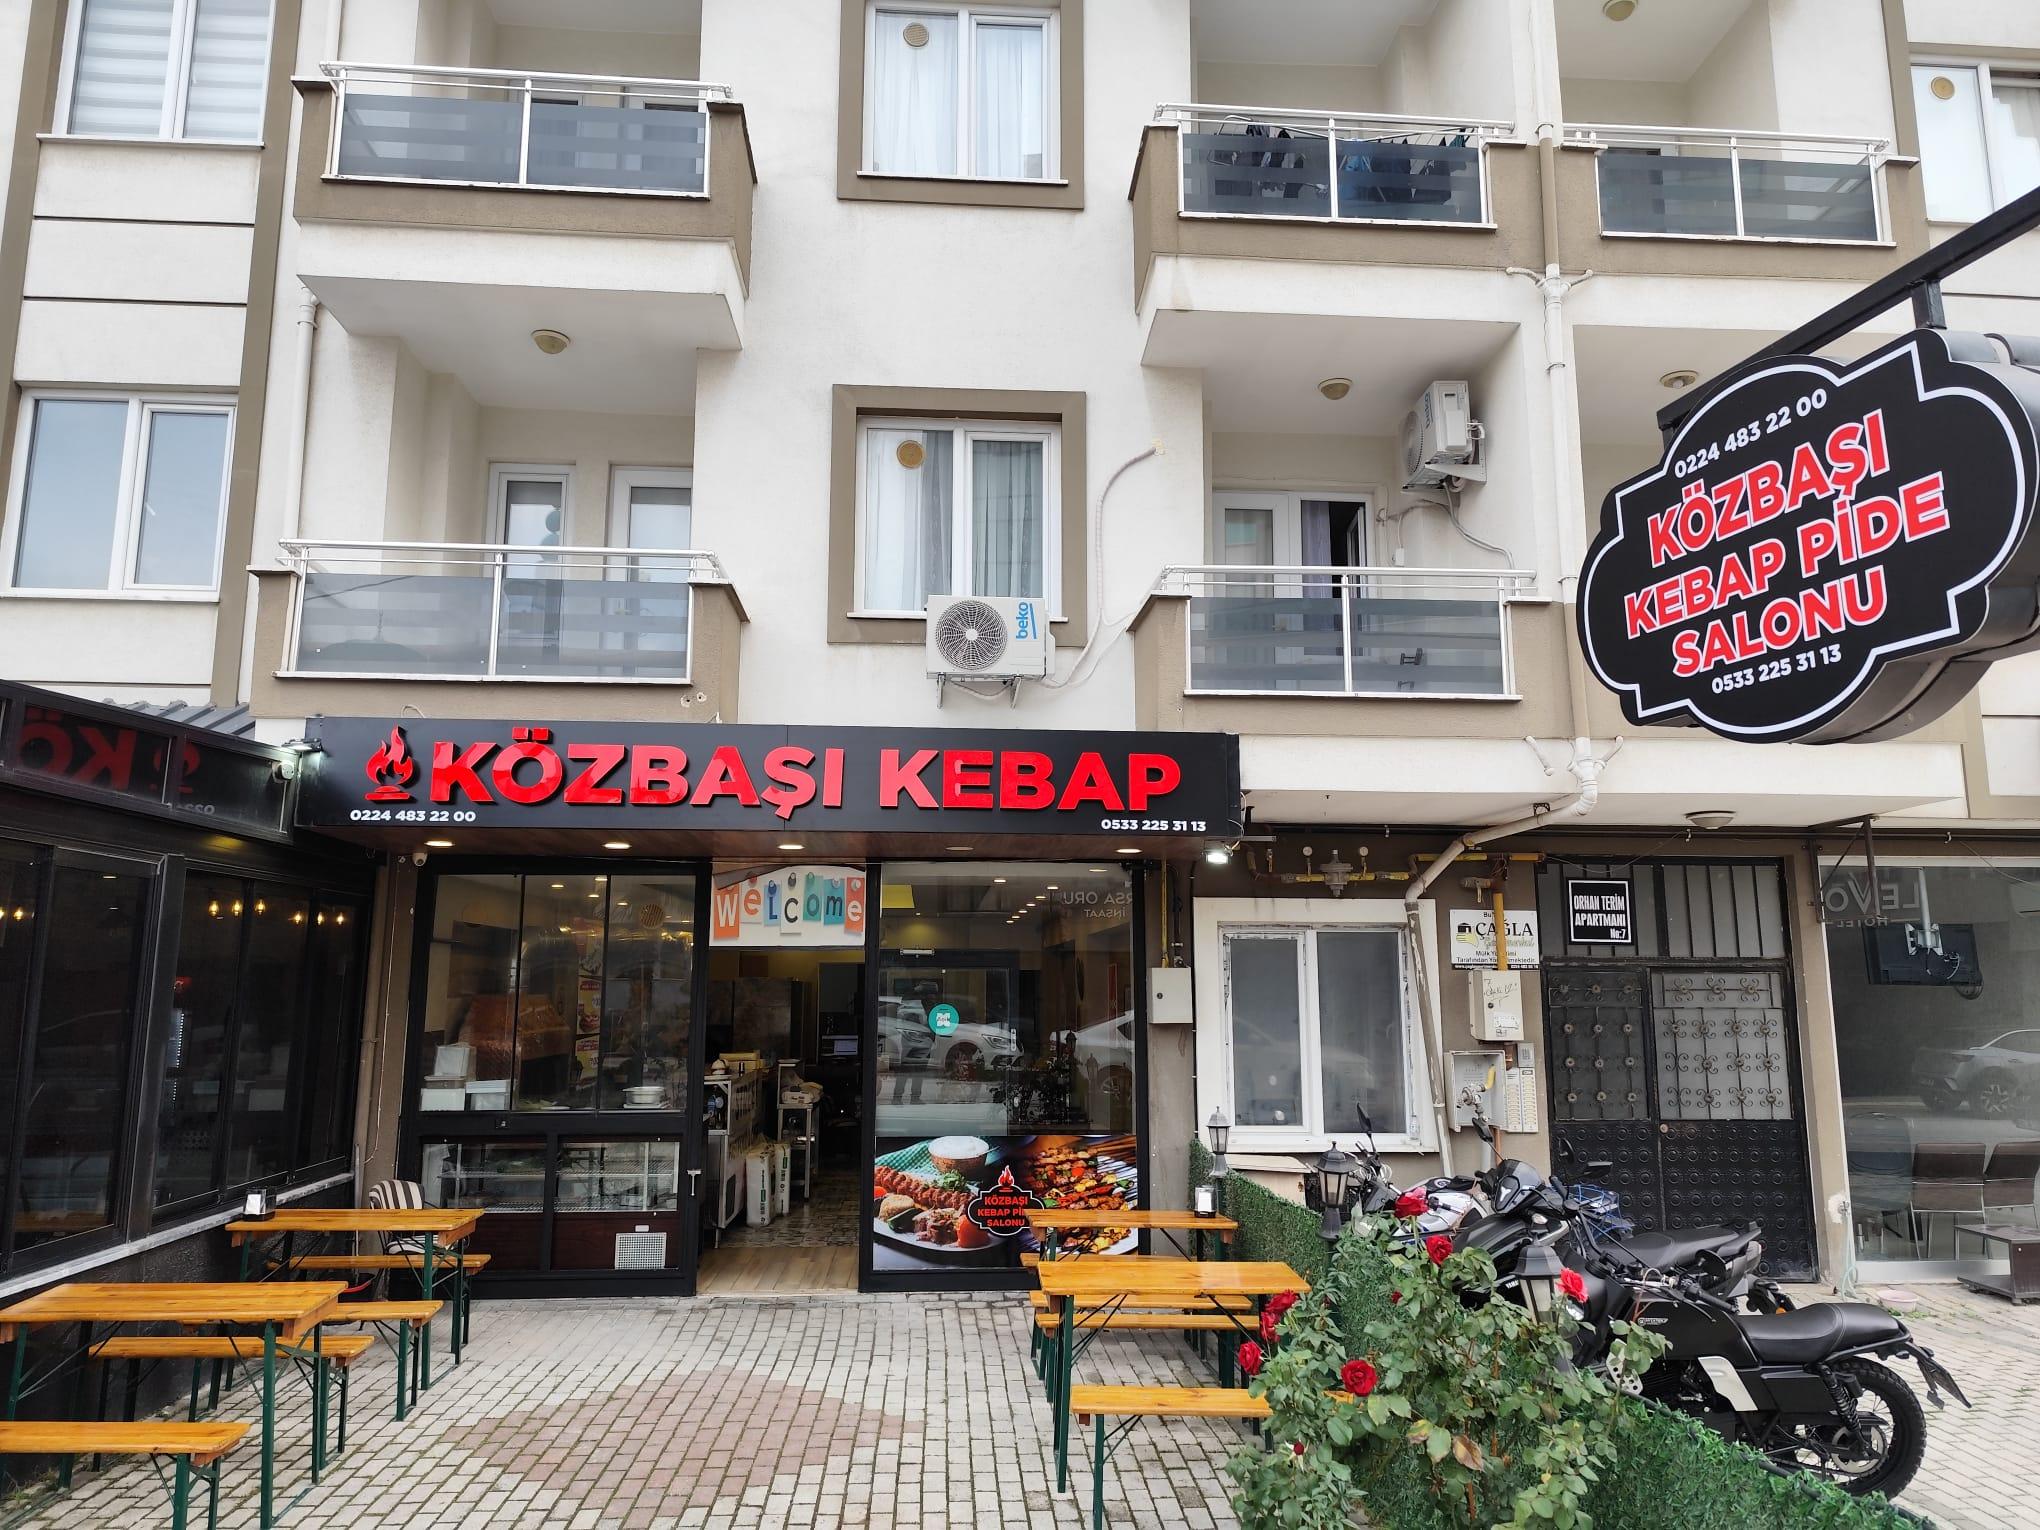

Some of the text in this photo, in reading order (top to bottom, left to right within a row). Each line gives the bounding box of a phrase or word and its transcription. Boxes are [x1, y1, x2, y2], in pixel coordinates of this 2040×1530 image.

[1674, 388, 1827, 478] 0224 483 22 00
[1647, 408, 1890, 568] KÖZBAŞI
[1623, 471, 1951, 640] KEBAP PİDE
[1016, 602, 1029, 640] beko
[1671, 564, 1888, 678] SALONU
[1711, 643, 1842, 694] 0533 225 31 13
[430, 727, 1182, 820] KÖZBAŞI KEBAP
[350, 809, 476, 822] 0224 483 22 00
[1101, 819, 1207, 832] 0533 225 31 13
[1573, 893, 1625, 911] ORHAN TERİM
[1575, 912, 1626, 927] APARTMANI
[977, 1208, 1010, 1216] KEBAP
[984, 1195, 1028, 1206] KÖZBAŞI
[987, 1219, 1025, 1227] SALONU
